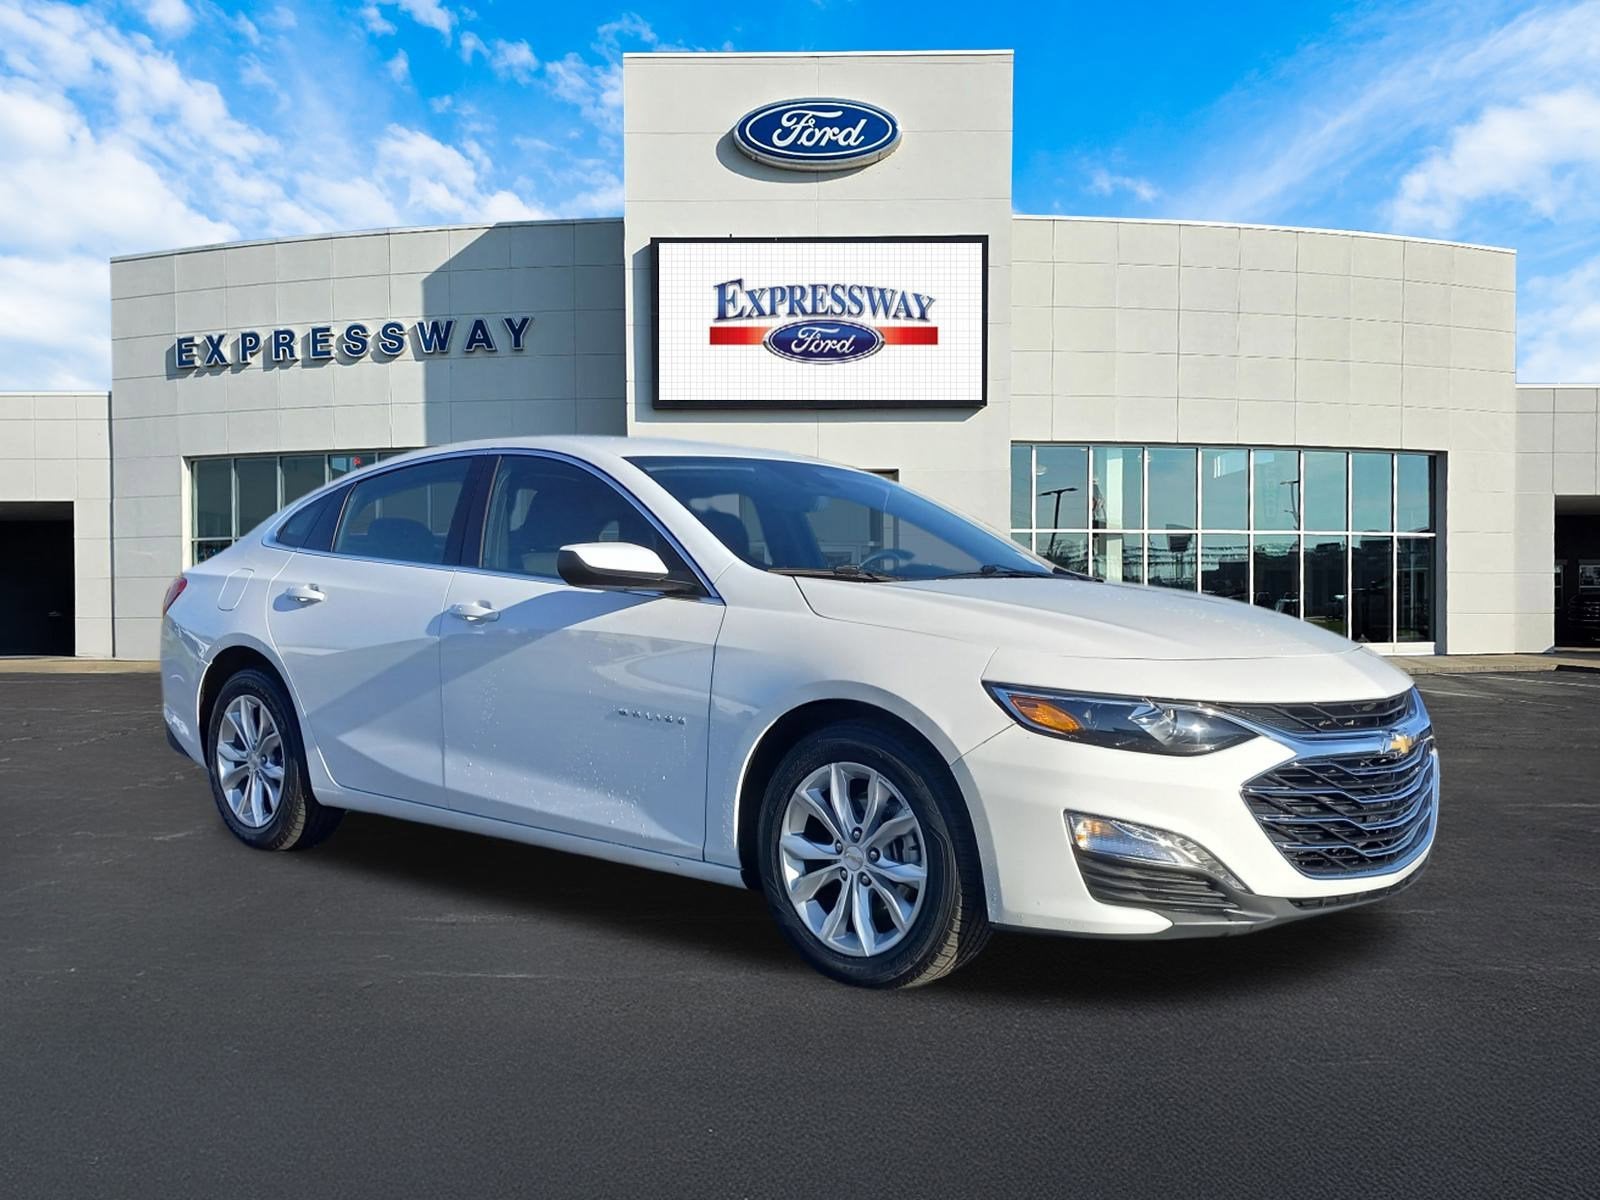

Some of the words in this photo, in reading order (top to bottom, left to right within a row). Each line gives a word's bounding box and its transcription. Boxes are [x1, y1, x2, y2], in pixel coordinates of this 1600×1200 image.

[771, 109, 867, 148] Ford
[713, 278, 936, 322] EXPRESSWAY
[175, 315, 533, 368] EXPRESSWAY
[791, 325, 855, 354] Ford
